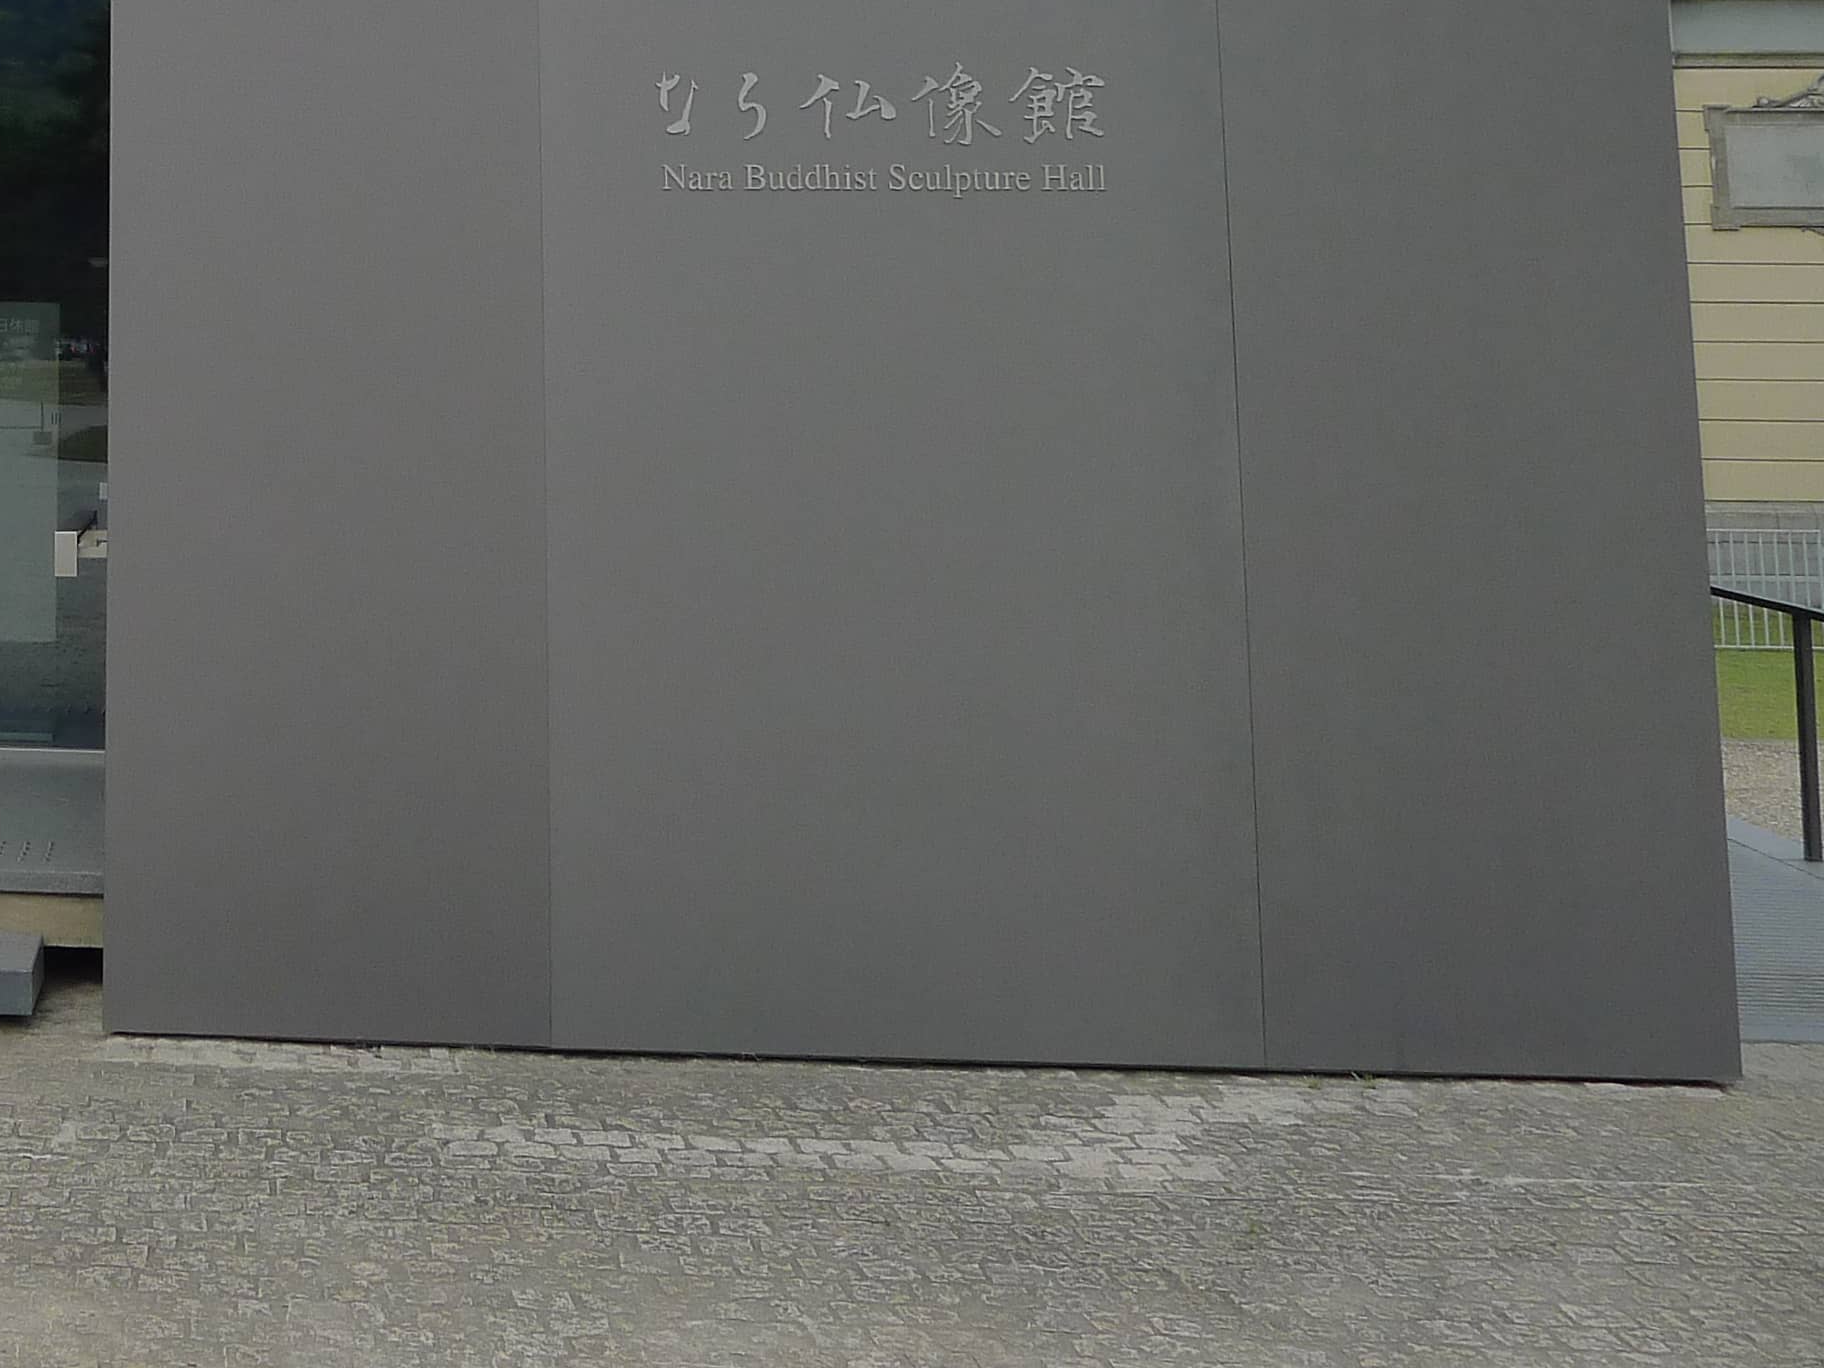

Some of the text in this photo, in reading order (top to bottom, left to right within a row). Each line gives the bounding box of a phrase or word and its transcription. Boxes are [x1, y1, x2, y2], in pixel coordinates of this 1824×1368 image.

[661, 162, 1107, 200] Nara Buddhist Sculpture Hall
